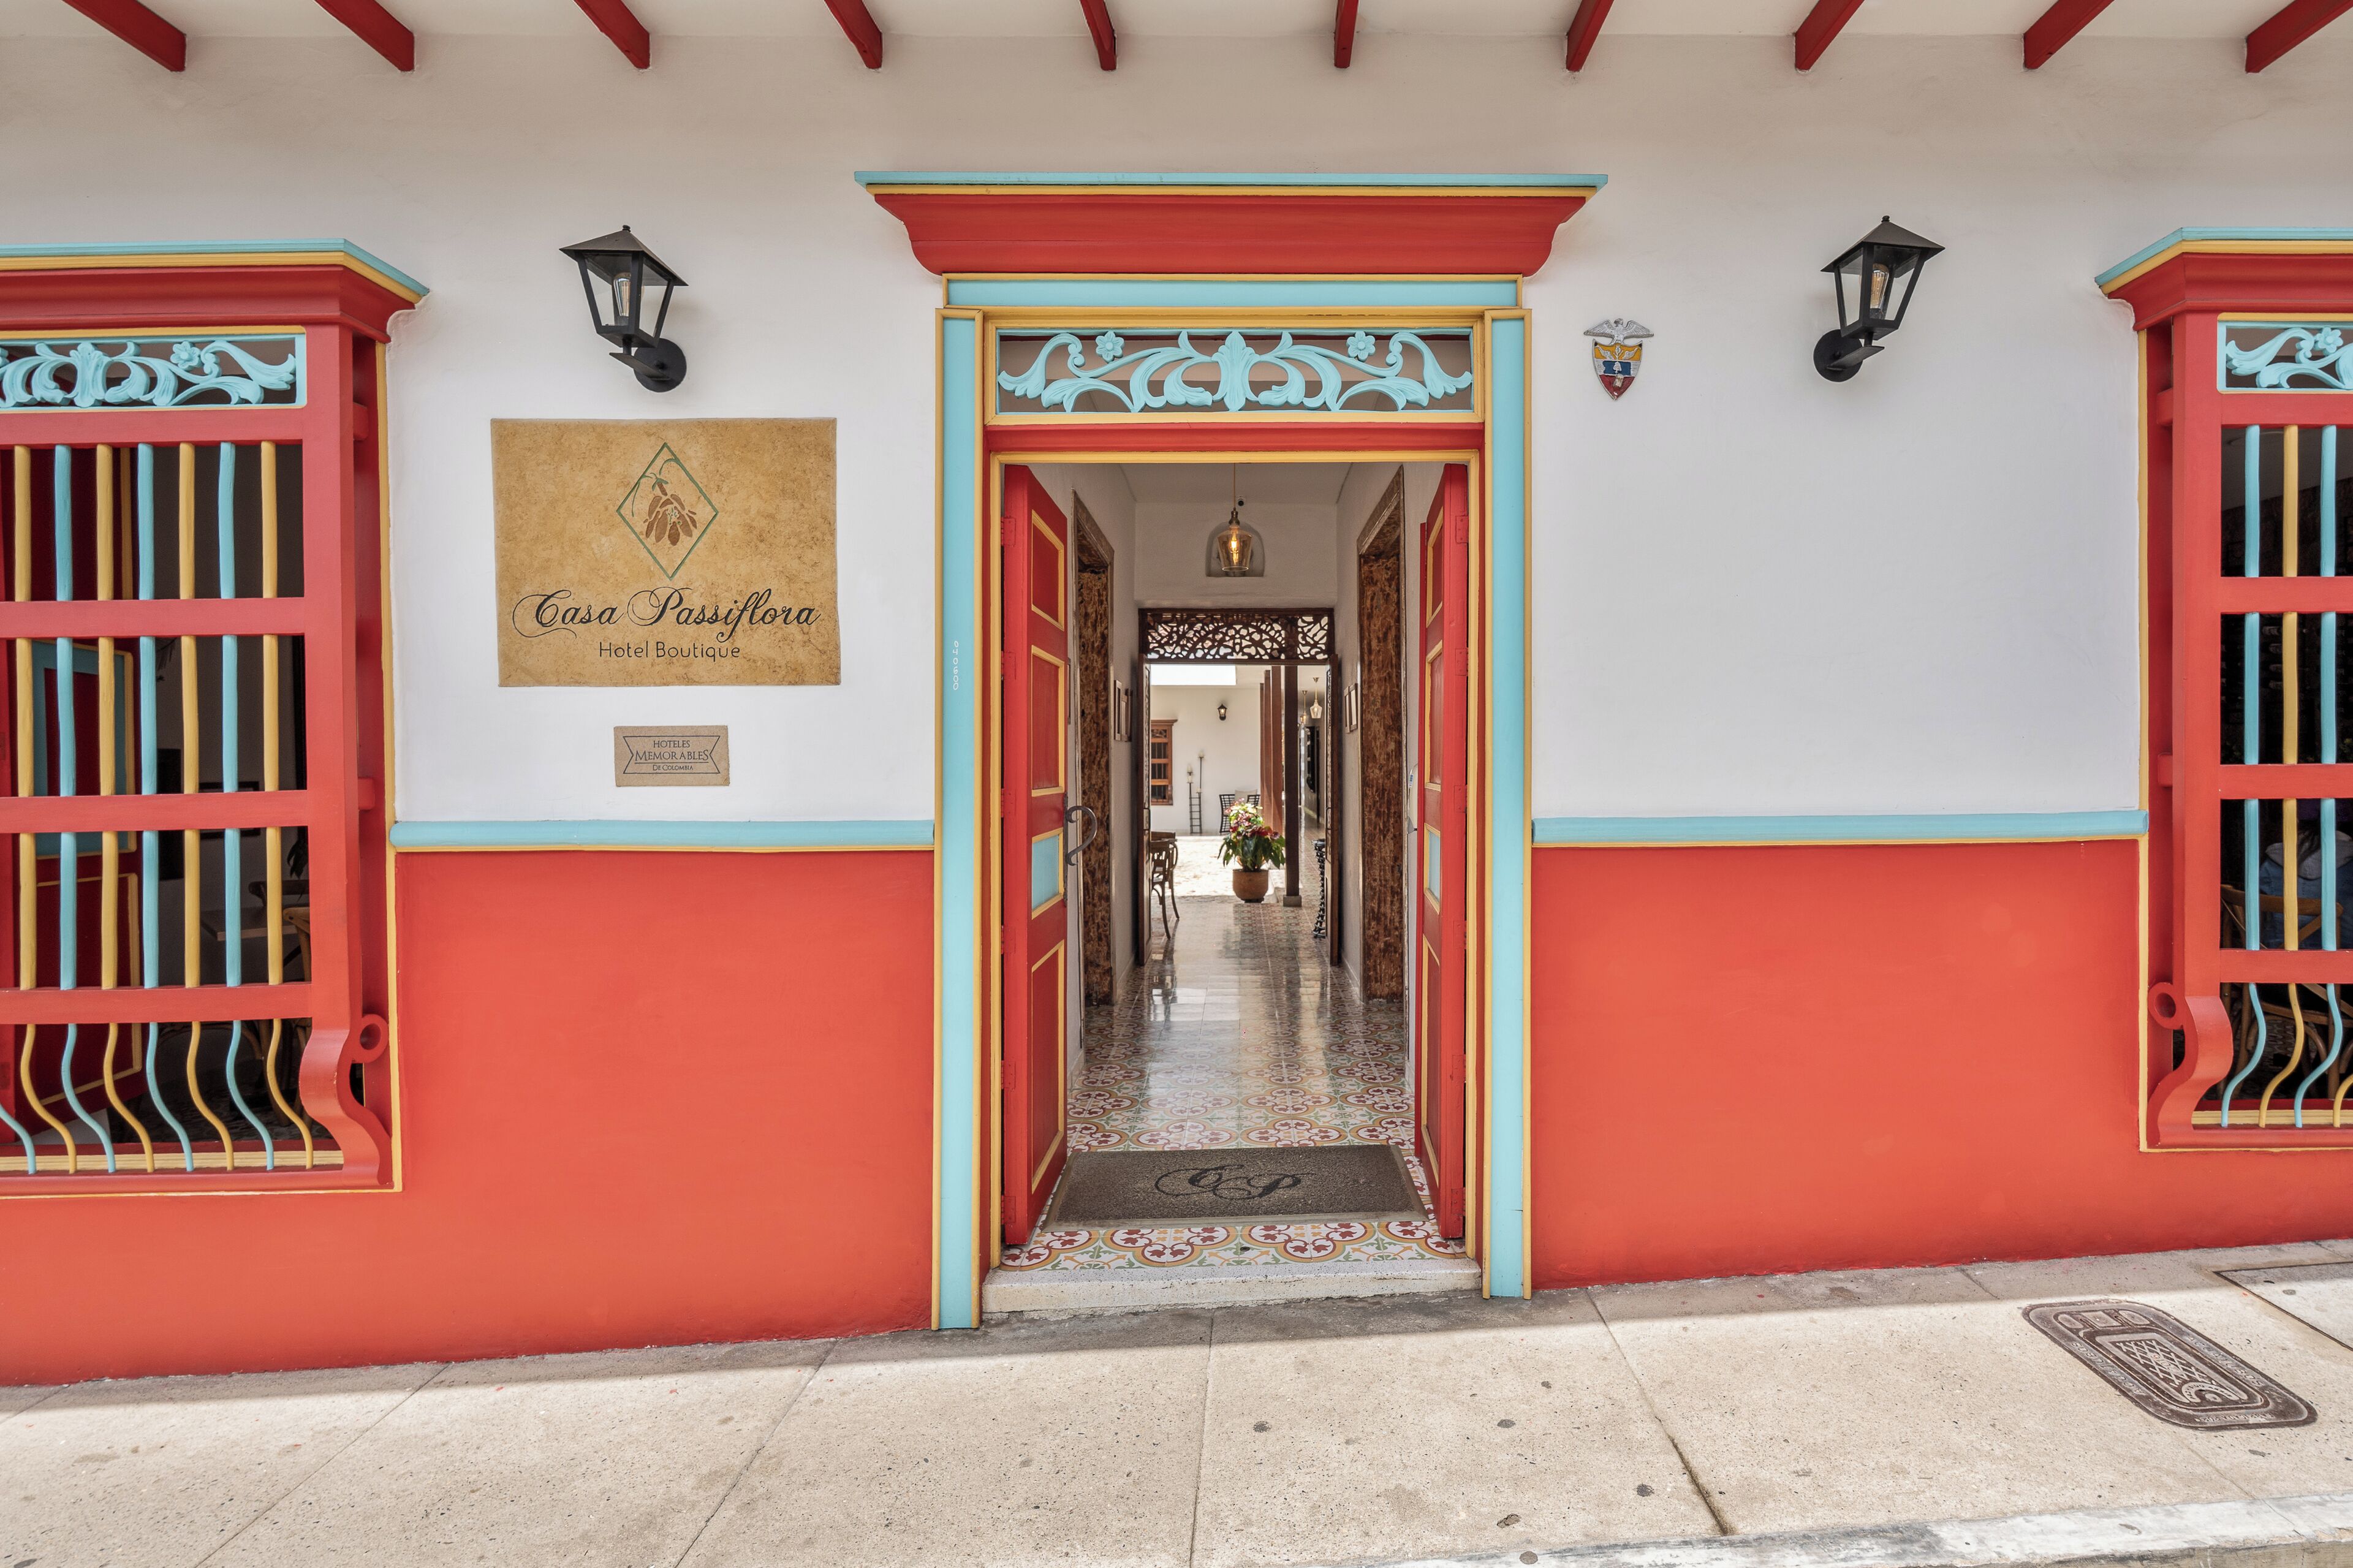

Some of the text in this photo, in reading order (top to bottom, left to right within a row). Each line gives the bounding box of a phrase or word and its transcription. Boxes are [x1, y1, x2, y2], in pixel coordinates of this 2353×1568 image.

[512, 586, 821, 643] Casa Passiflora
[599, 641, 740, 662] Hotel Boutique
[635, 749, 709, 761] MEMORABLES
